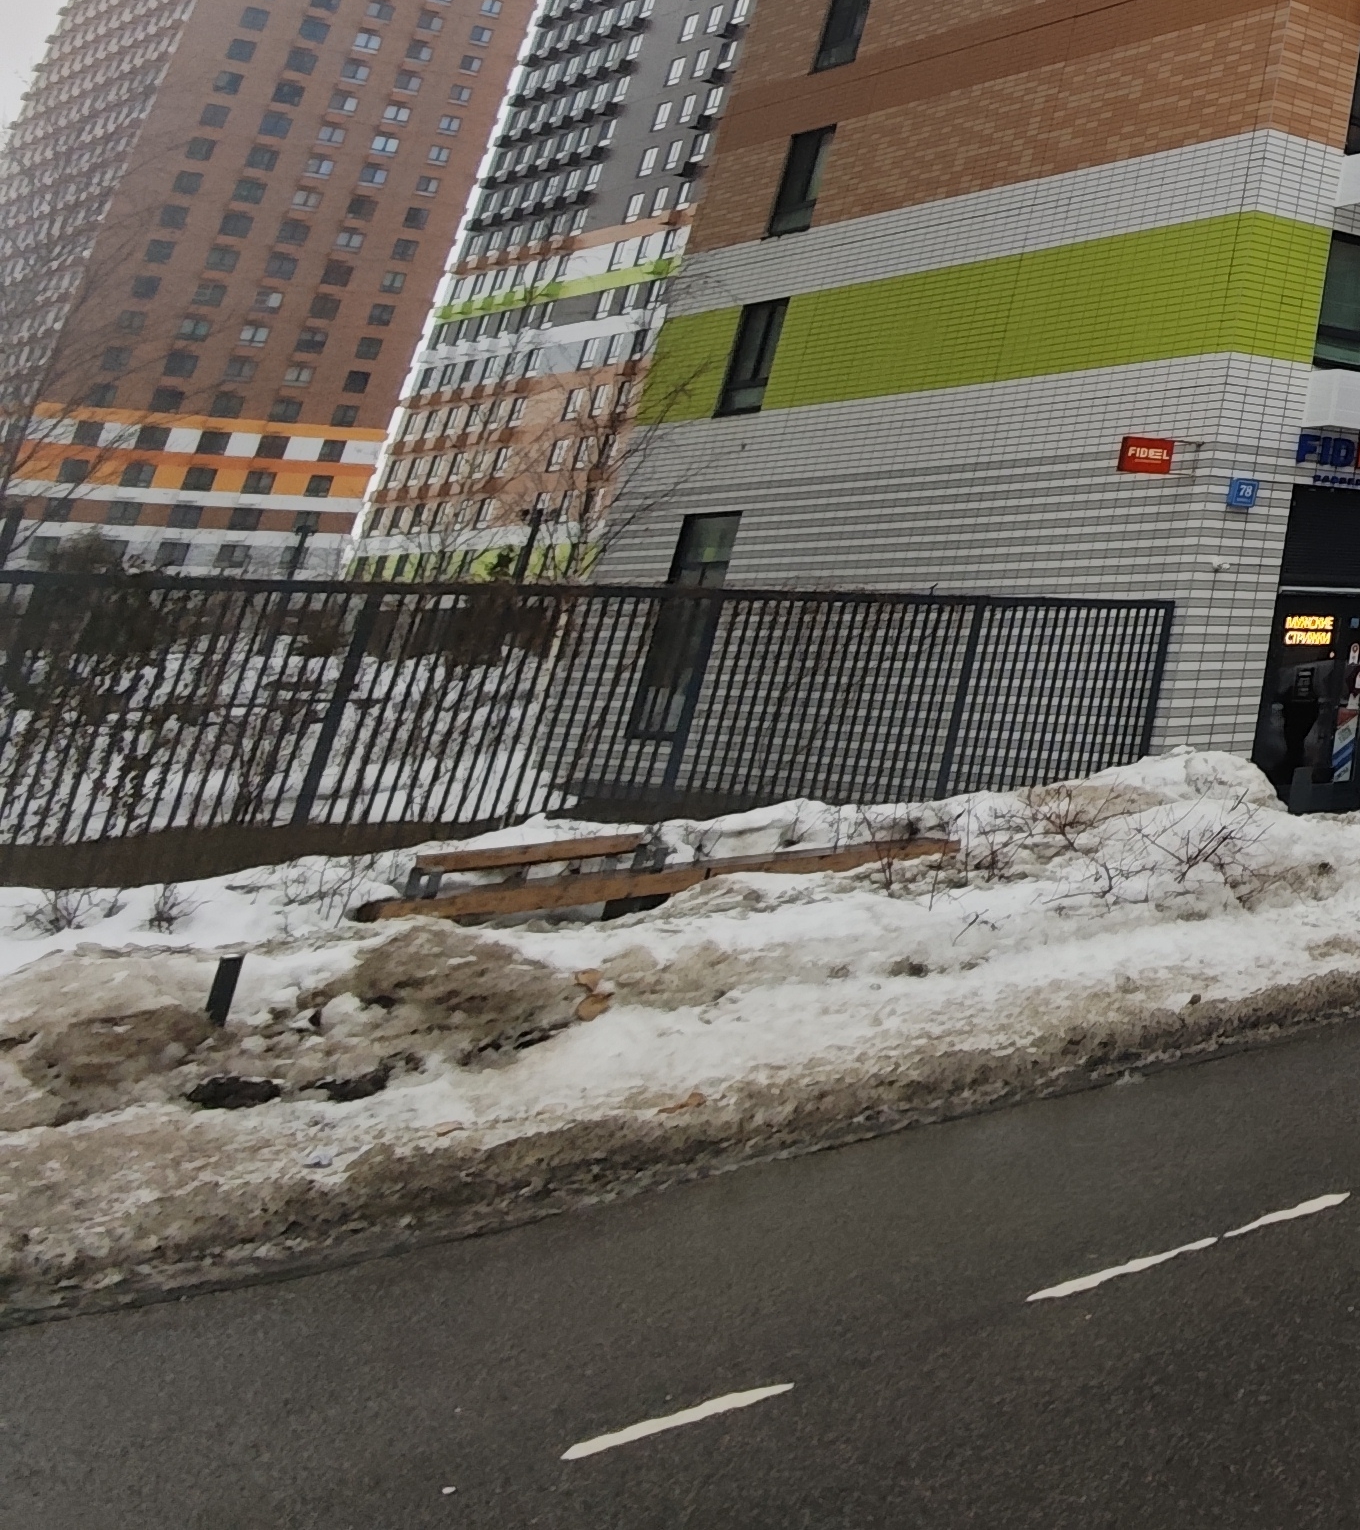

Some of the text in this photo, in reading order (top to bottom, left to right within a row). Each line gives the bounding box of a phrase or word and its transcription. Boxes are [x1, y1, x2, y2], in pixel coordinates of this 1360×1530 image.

[1128, 447, 1170, 460] FIDEL
[1240, 485, 1253, 497] 78
[1285, 616, 1334, 630] МУЖСКИЕ
[1285, 631, 1332, 645] СТРИЖКИ
